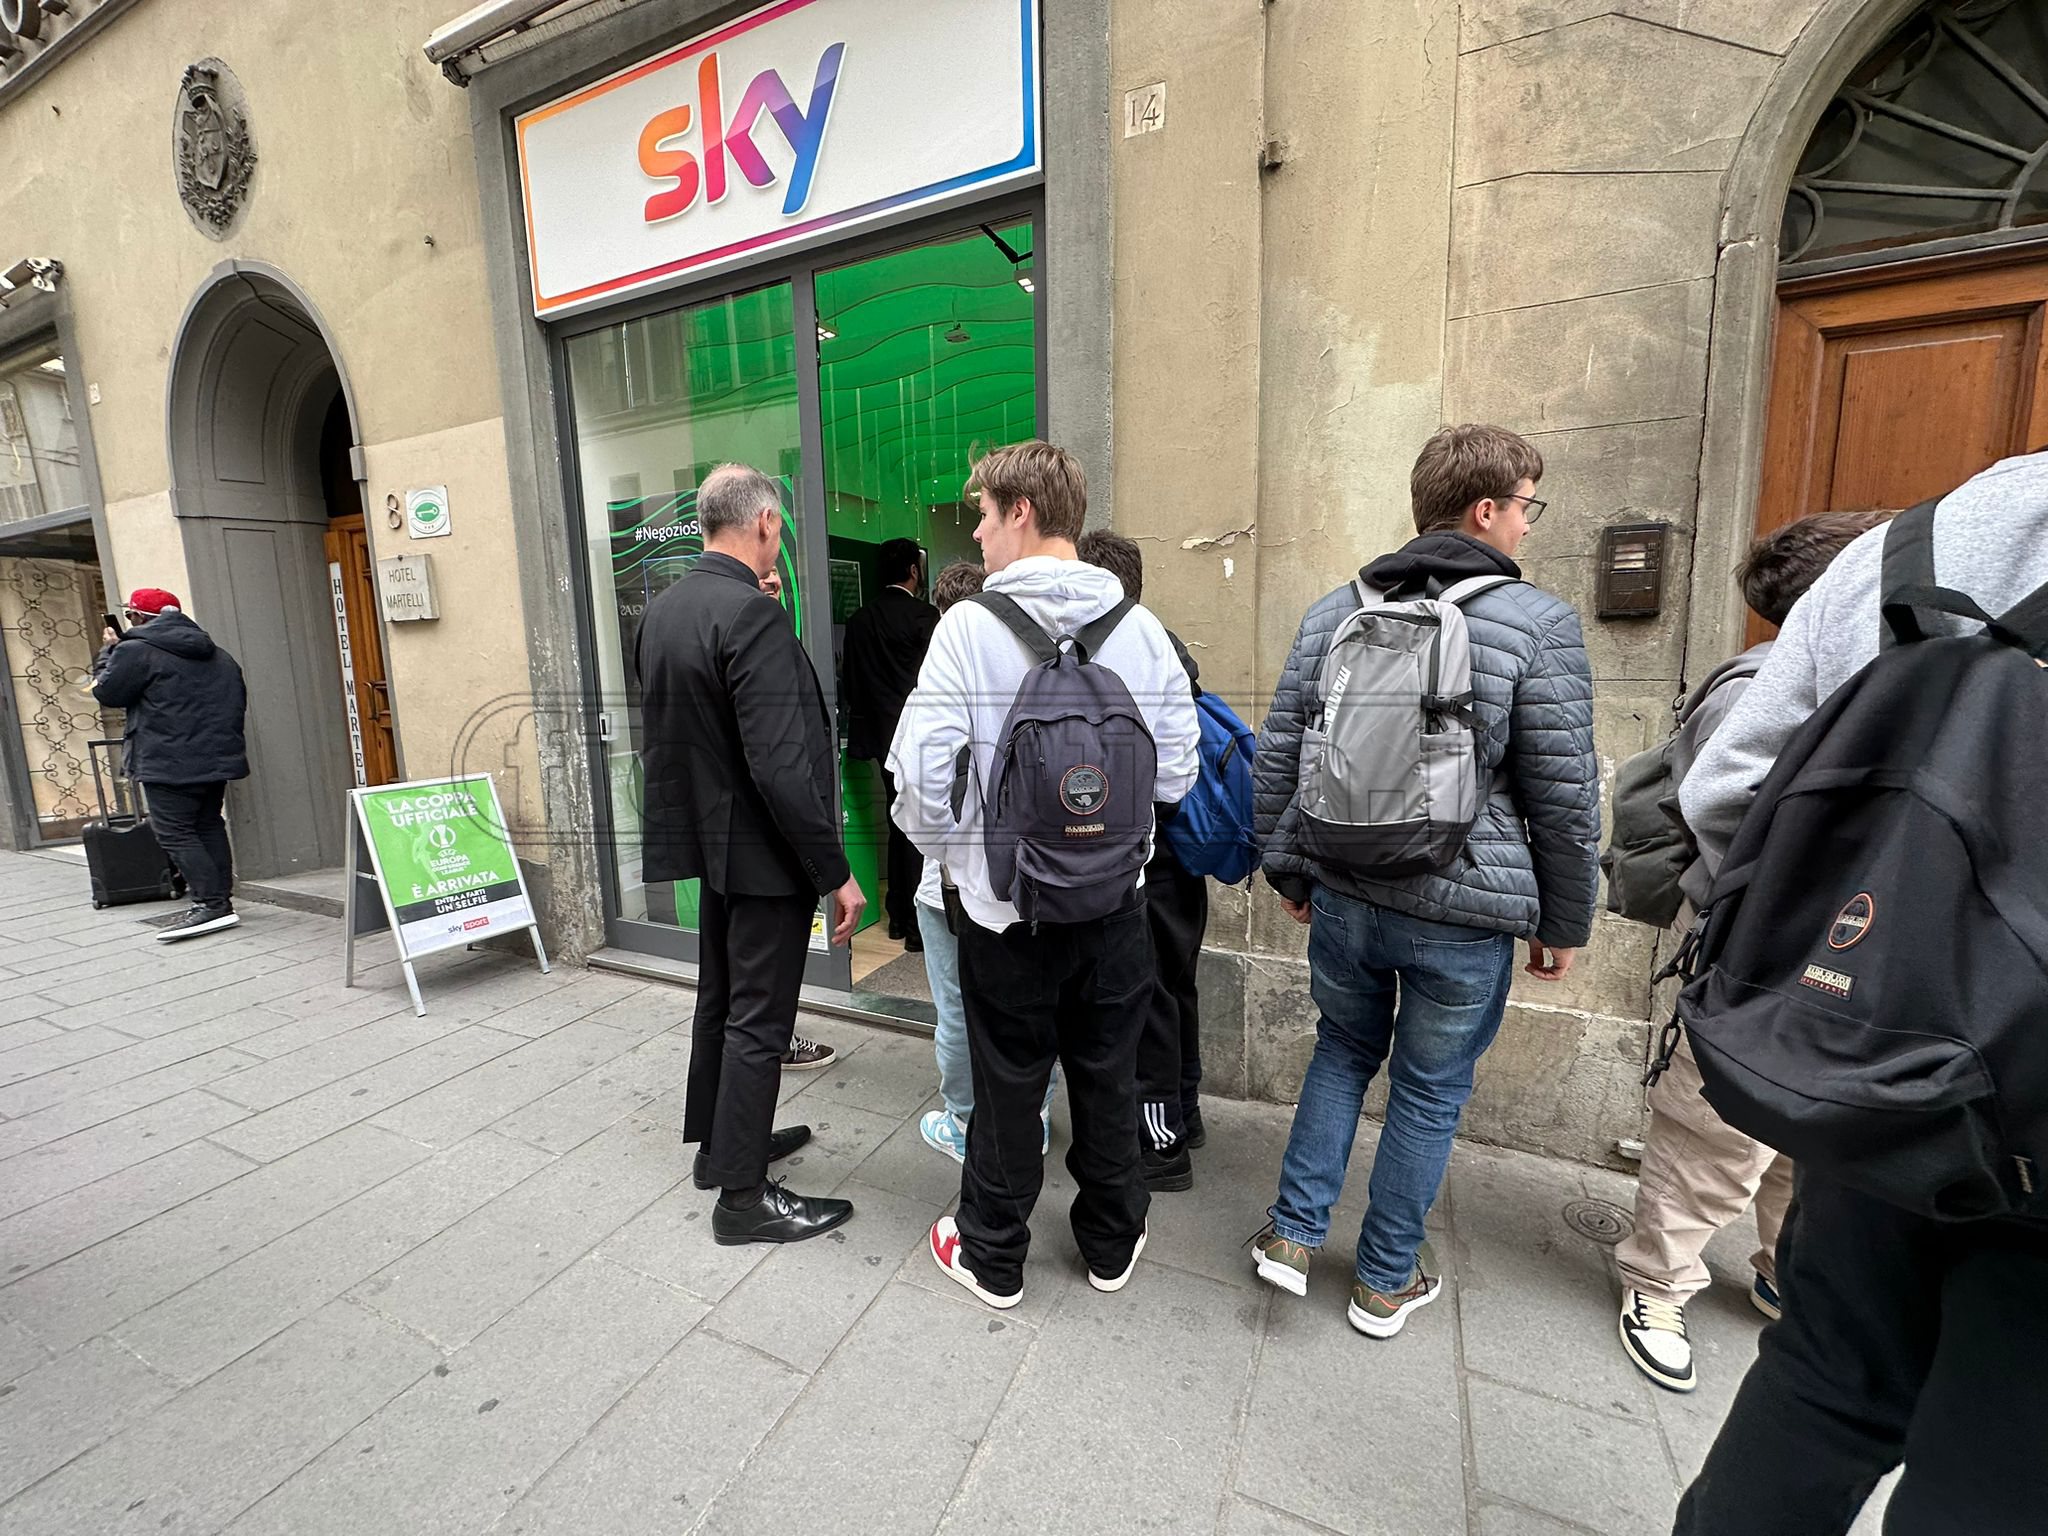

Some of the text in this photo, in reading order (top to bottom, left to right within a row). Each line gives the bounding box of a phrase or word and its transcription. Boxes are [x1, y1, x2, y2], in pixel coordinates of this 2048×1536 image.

[1131, 94, 1161, 127] 14
[637, 42, 847, 224] sky
[386, 492, 402, 530] 8
[635, 520, 702, 542] #NegozioS
[388, 567, 417, 583] HOTEL
[386, 592, 425, 609] MARTELLI
[332, 578, 351, 669] HOTEL
[386, 791, 477, 814] LA COPPA
[391, 803, 479, 828] UFFICIALE
[430, 854, 470, 868] EUROPA
[411, 870, 500, 899] È ARRIVATA
[434, 893, 461, 906] ENTRA
[436, 894, 488, 914] UN SELFIE
[448, 917, 488, 934] sky sport
